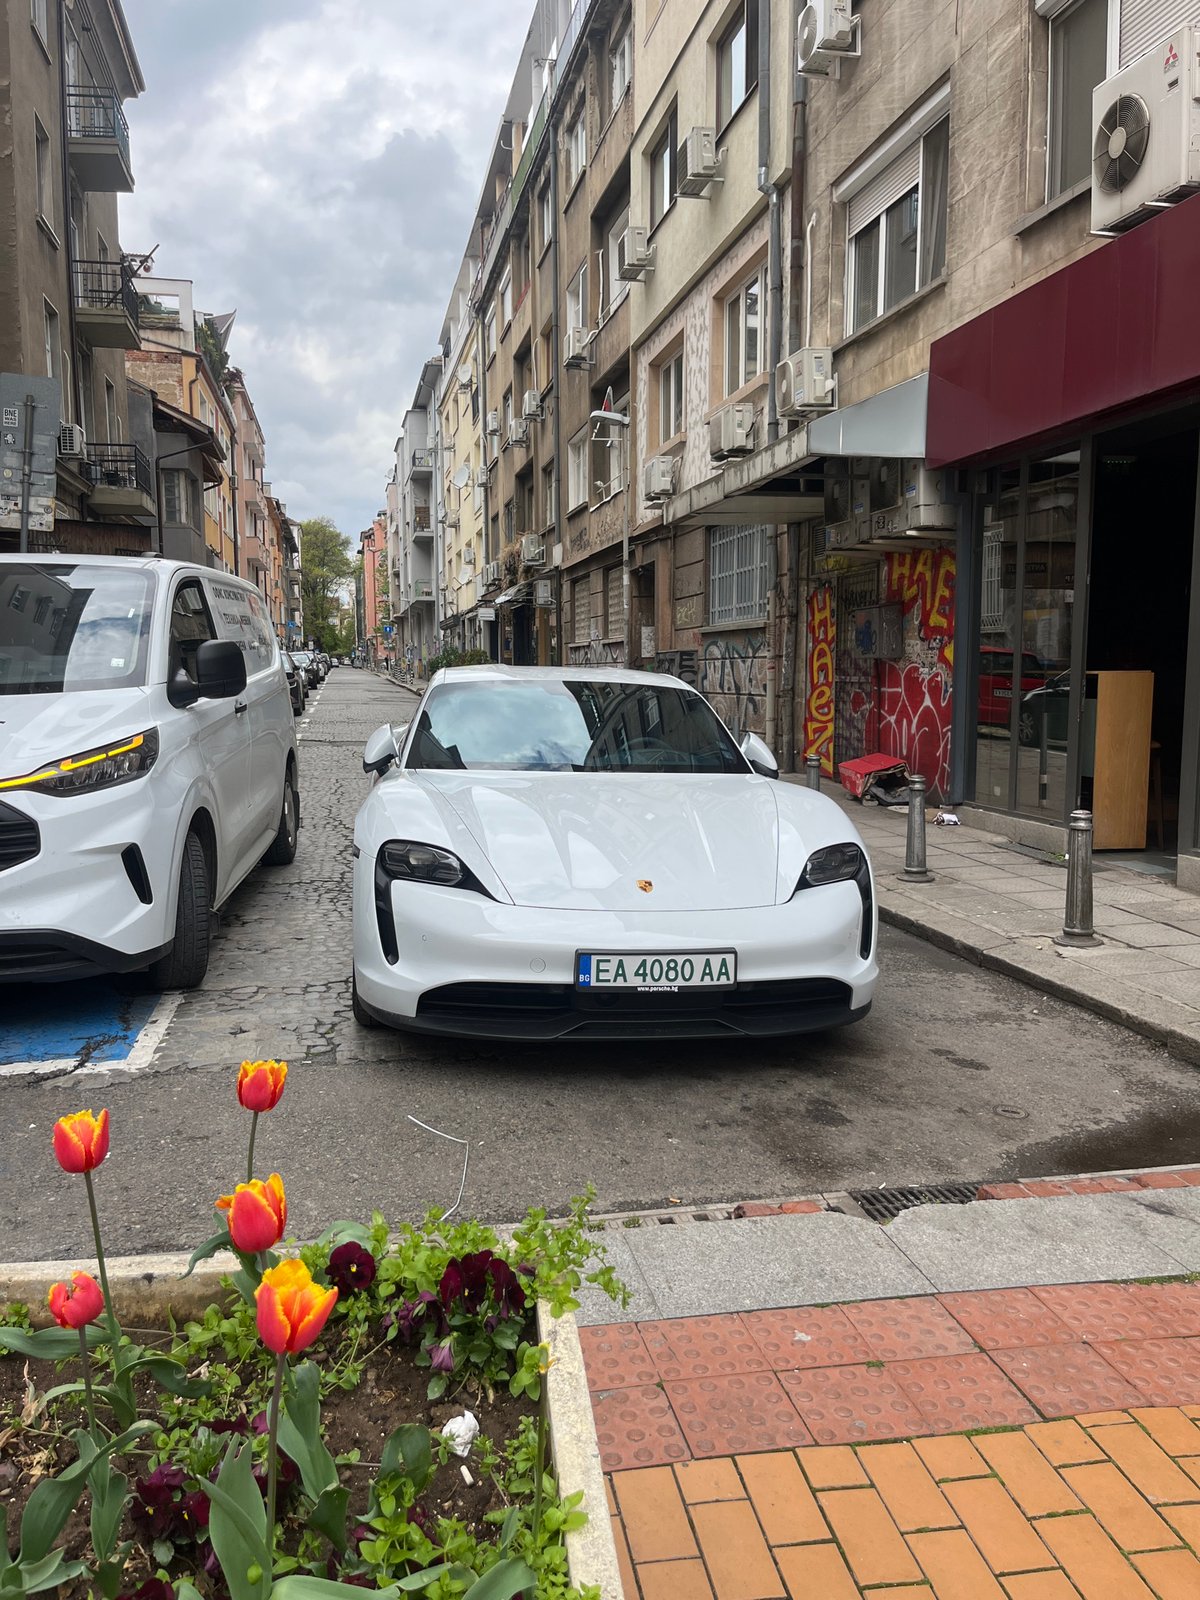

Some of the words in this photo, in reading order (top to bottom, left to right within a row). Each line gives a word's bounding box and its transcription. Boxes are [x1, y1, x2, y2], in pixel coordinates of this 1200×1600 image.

[4, 409, 17, 417] BNE
[595, 958, 628, 983] EA
[634, 958, 695, 983] 4080
[700, 957, 731, 982] AA
[579, 974, 590, 982] BG
